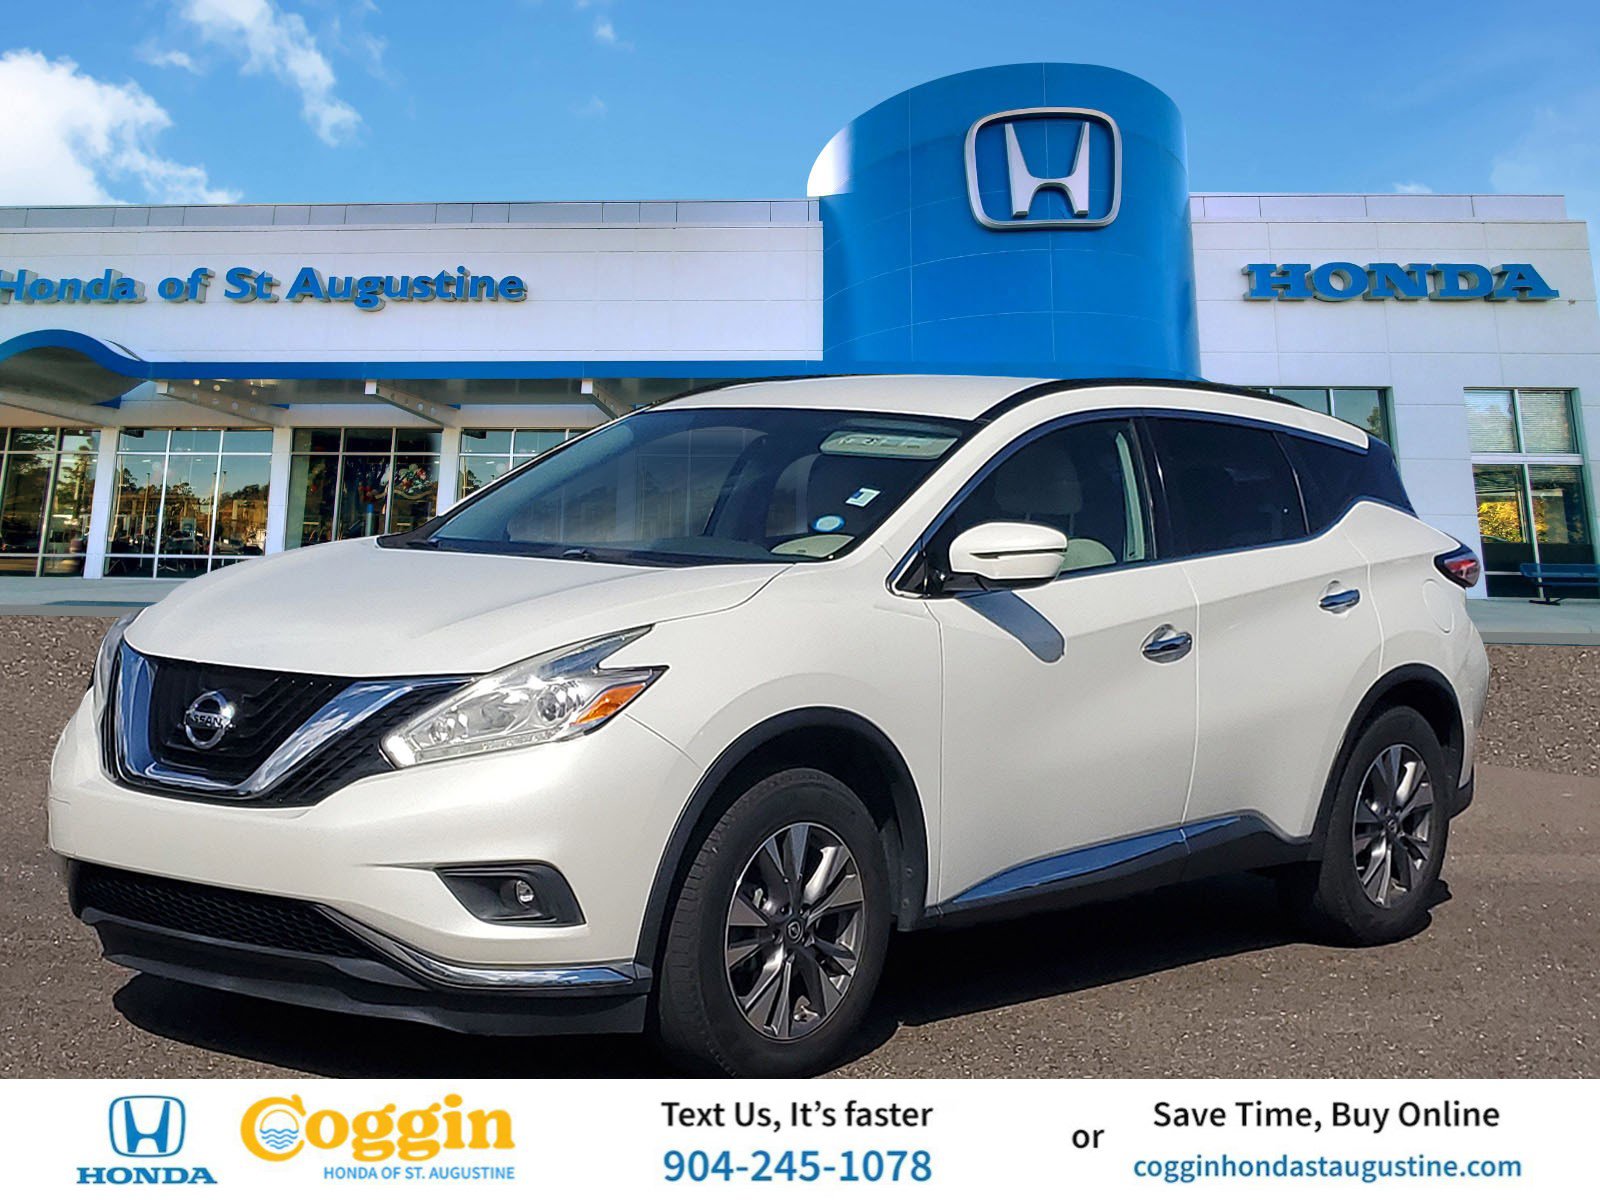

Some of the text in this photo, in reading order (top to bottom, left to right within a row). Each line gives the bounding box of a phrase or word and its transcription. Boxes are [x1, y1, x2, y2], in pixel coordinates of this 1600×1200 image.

[0, 265, 528, 312] Honda of St Augustine
[1241, 261, 1561, 303] HONDA
